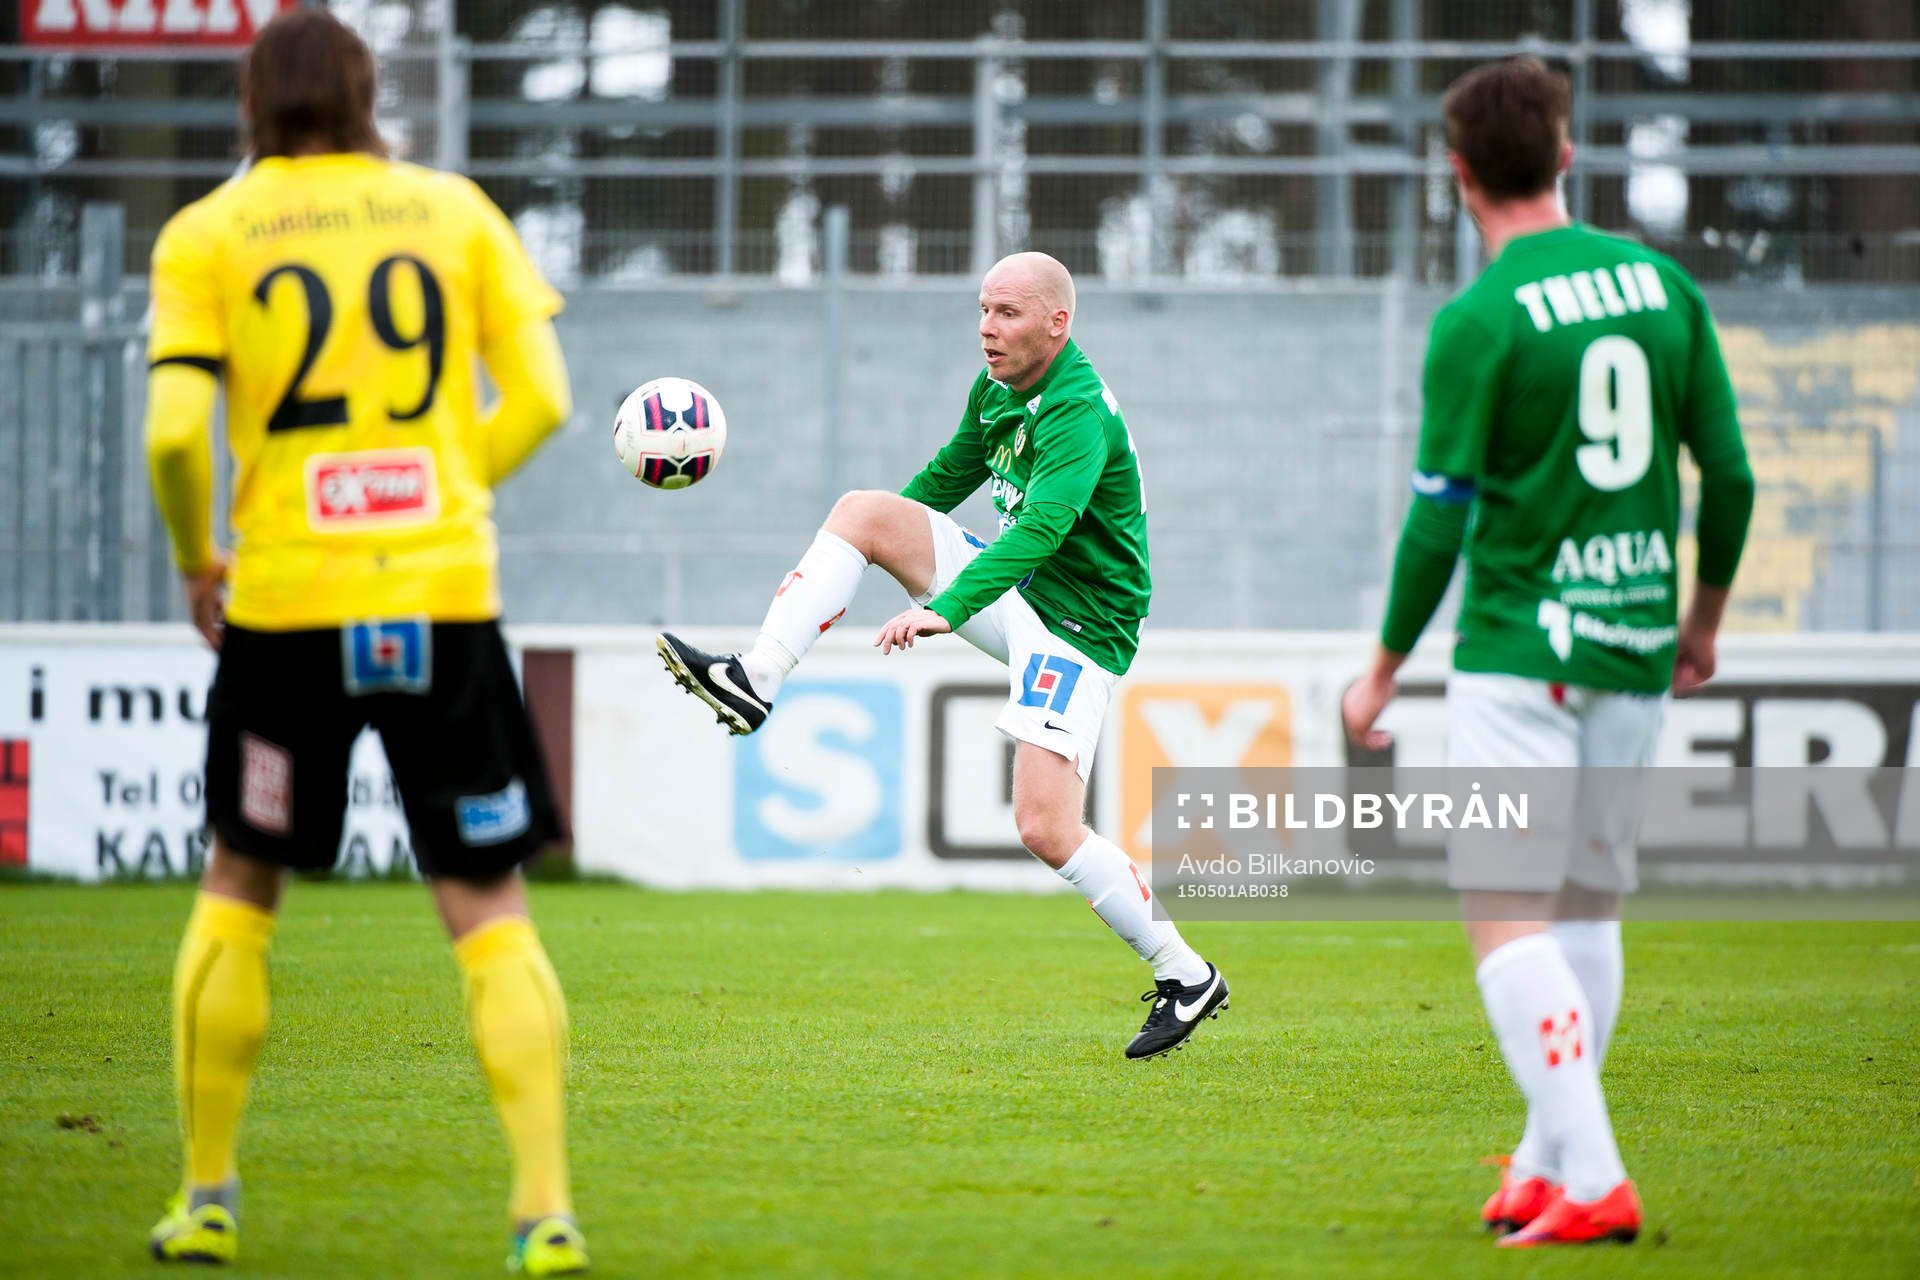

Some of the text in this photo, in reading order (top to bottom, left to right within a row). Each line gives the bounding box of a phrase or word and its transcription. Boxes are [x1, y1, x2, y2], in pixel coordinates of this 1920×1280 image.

[1515, 262, 1668, 332] THELIN
[253, 256, 445, 434] 29
[1577, 335, 1653, 491] 9
[1552, 530, 1671, 585] AQUA
[31, 668, 44, 722] i
[98, 771, 158, 805] Tel
